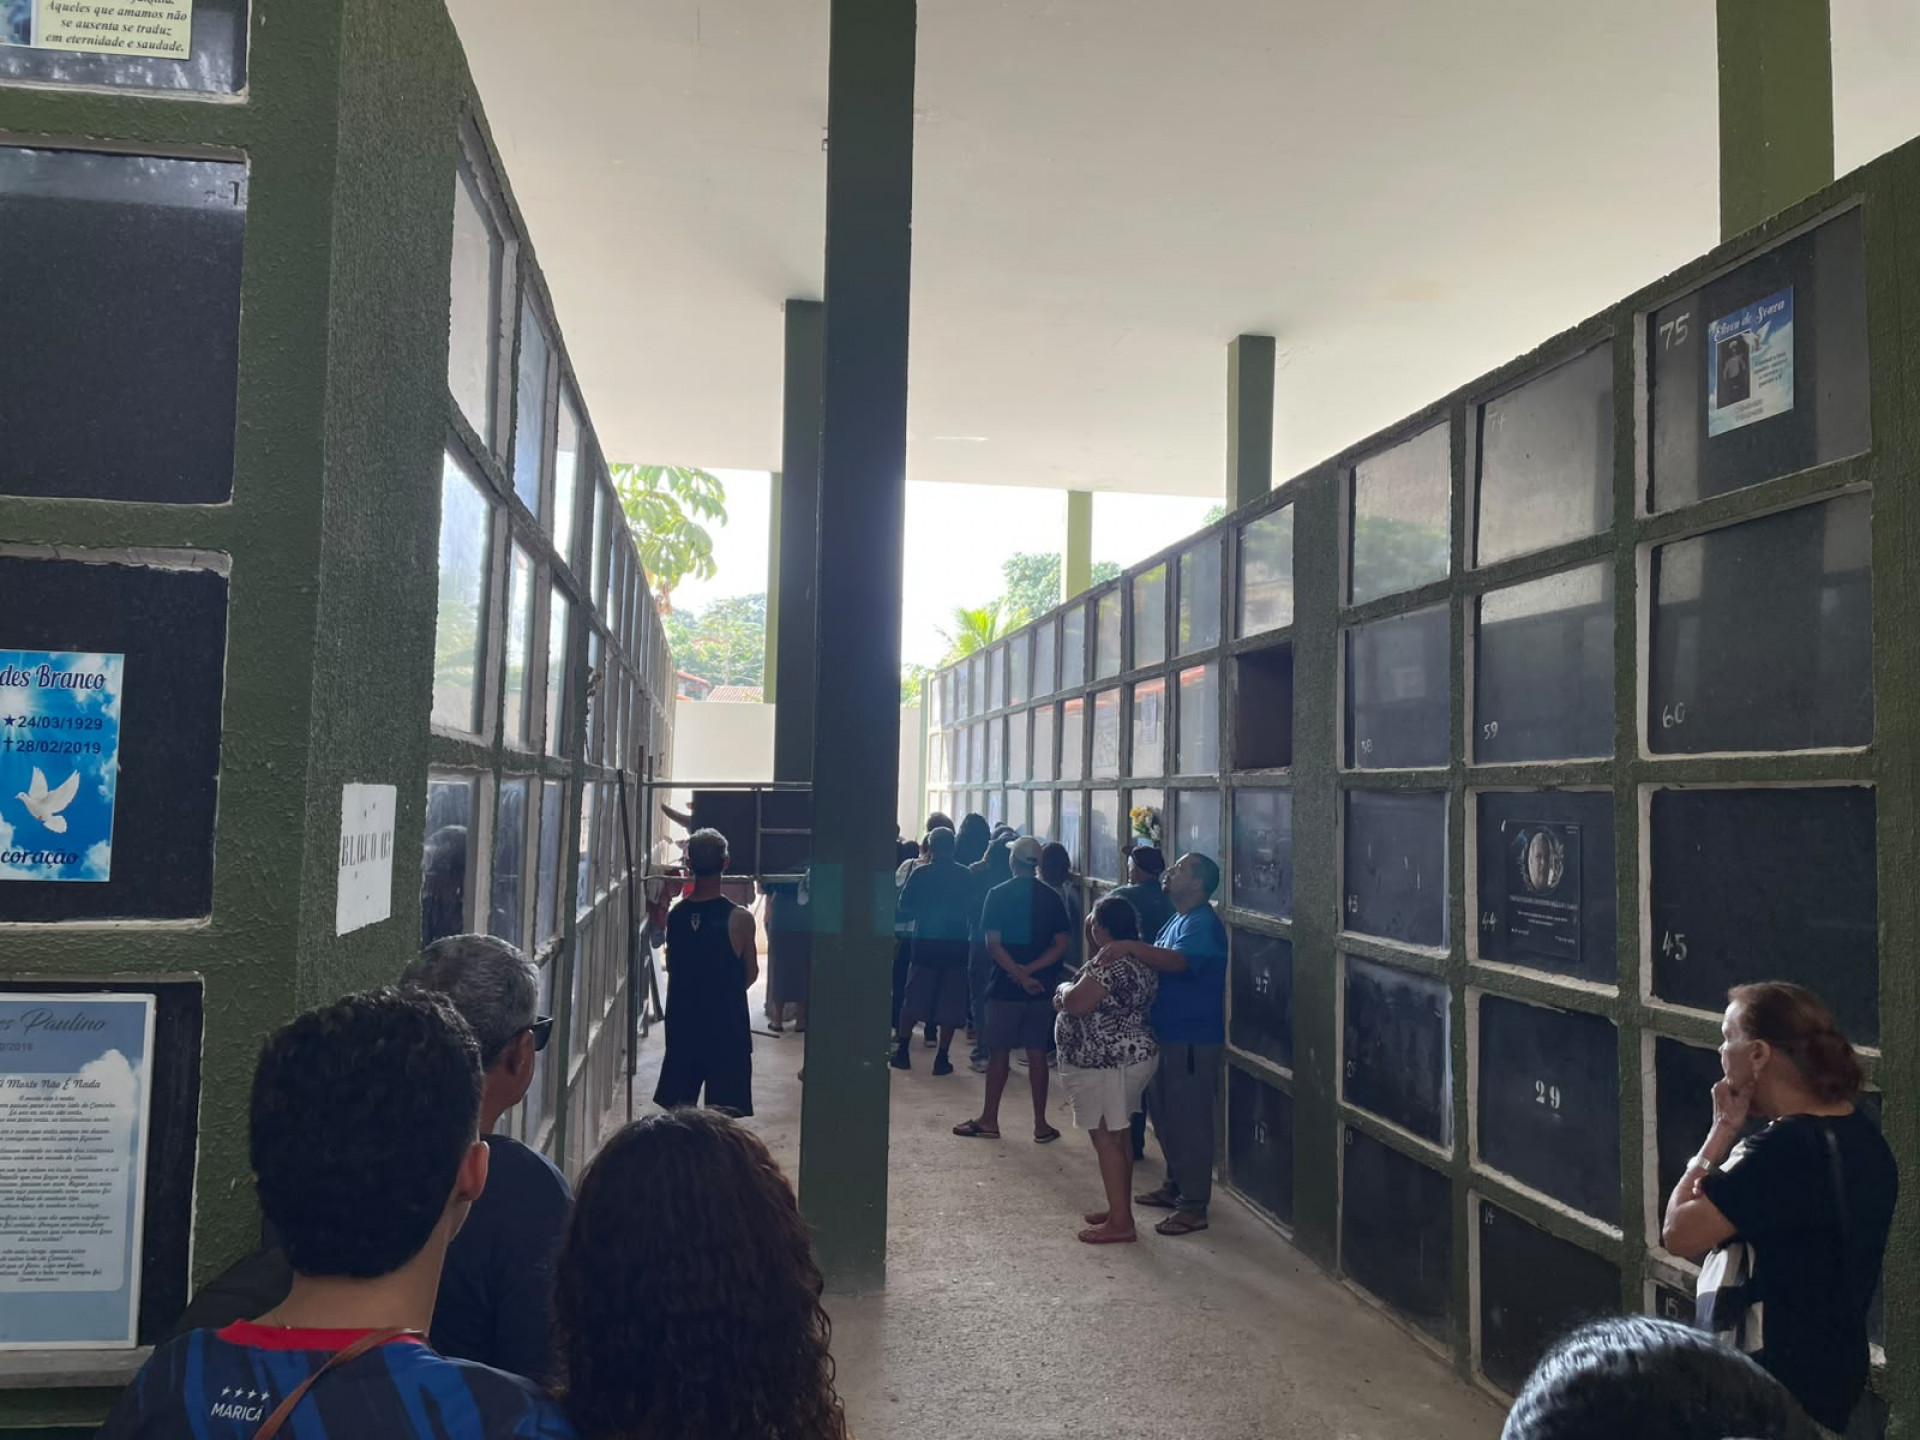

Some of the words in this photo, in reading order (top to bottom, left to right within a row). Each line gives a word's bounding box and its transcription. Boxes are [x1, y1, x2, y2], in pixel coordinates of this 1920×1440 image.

[46, 0, 91, 16] Aqueles
[93, 5, 115, 18] que
[117, 8, 164, 20] amamos
[166, 11, 188, 22] não
[60, 20, 73, 28] se
[75, 20, 120, 32] ausenta
[121, 24, 135, 33] se
[136, 22, 174, 37] traduz
[45, 34, 63, 43] em
[65, 32, 126, 48] eternidade
[127, 40, 135, 49] e
[136, 37, 185, 52] saudade.
[1659, 312, 1691, 352] 75
[35, 664, 107, 690] Branco
[17, 715, 103, 731] 24/03/1929
[1662, 701, 1686, 729] 60
[1483, 719, 1499, 741] 59
[16, 740, 102, 755] 28/02/2019
[1361, 738, 1373, 755] 58
[0, 848, 79, 869] coração
[341, 832, 377, 868] BLOCO
[1482, 911, 1498, 932] 44
[1662, 930, 1689, 961] 45
[20, 1008, 108, 1037] Paulino
[7, 1079, 38, 1089] Morte
[41, 1078, 61, 1089] Não
[73, 1079, 102, 1089] Nada
[1534, 1079, 1561, 1110] 29
[210, 1402, 264, 1422] MARICÁ
